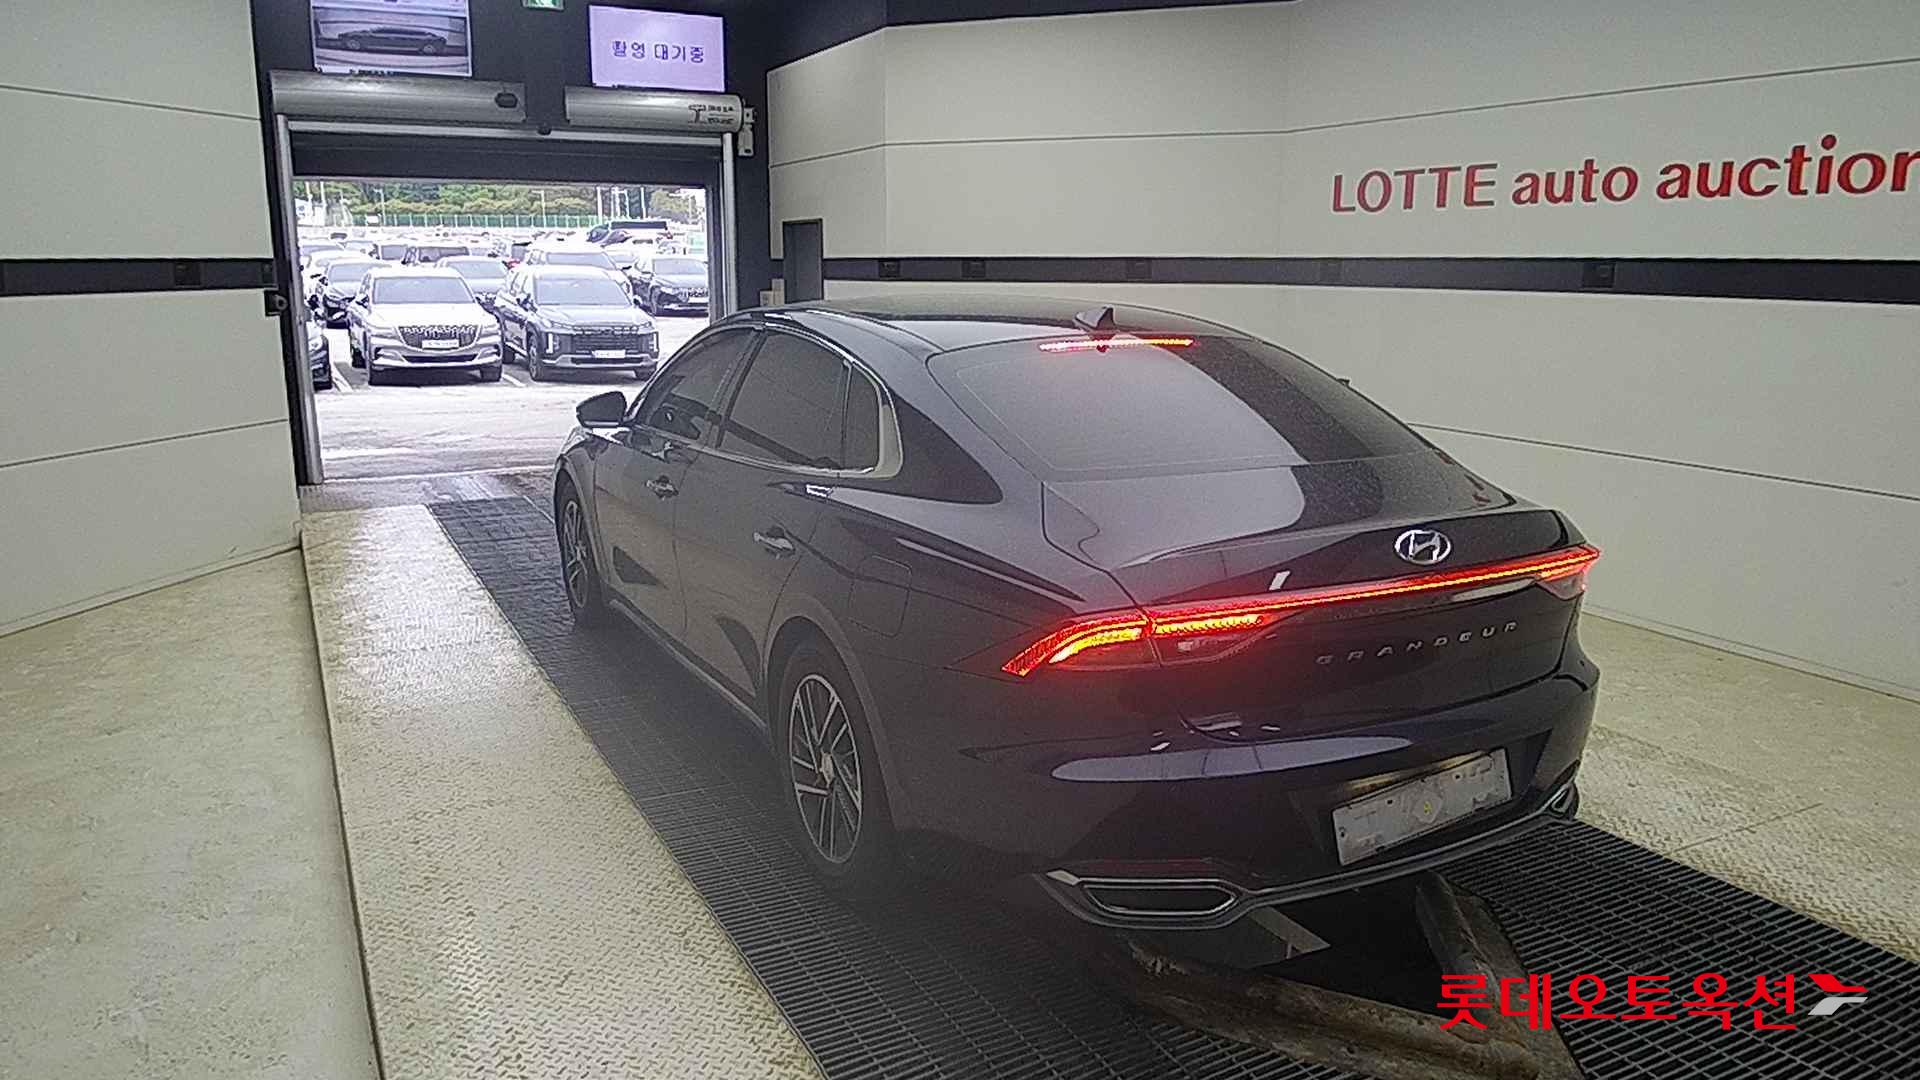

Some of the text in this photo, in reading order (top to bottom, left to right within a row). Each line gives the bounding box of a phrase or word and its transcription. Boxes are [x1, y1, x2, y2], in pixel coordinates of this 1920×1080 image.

[612, 40, 704, 63] 촬영 대기중
[1332, 163, 1498, 213] LOTTE
[1511, 158, 1638, 206] auto
[1316, 621, 1517, 665] GRANDEUR
